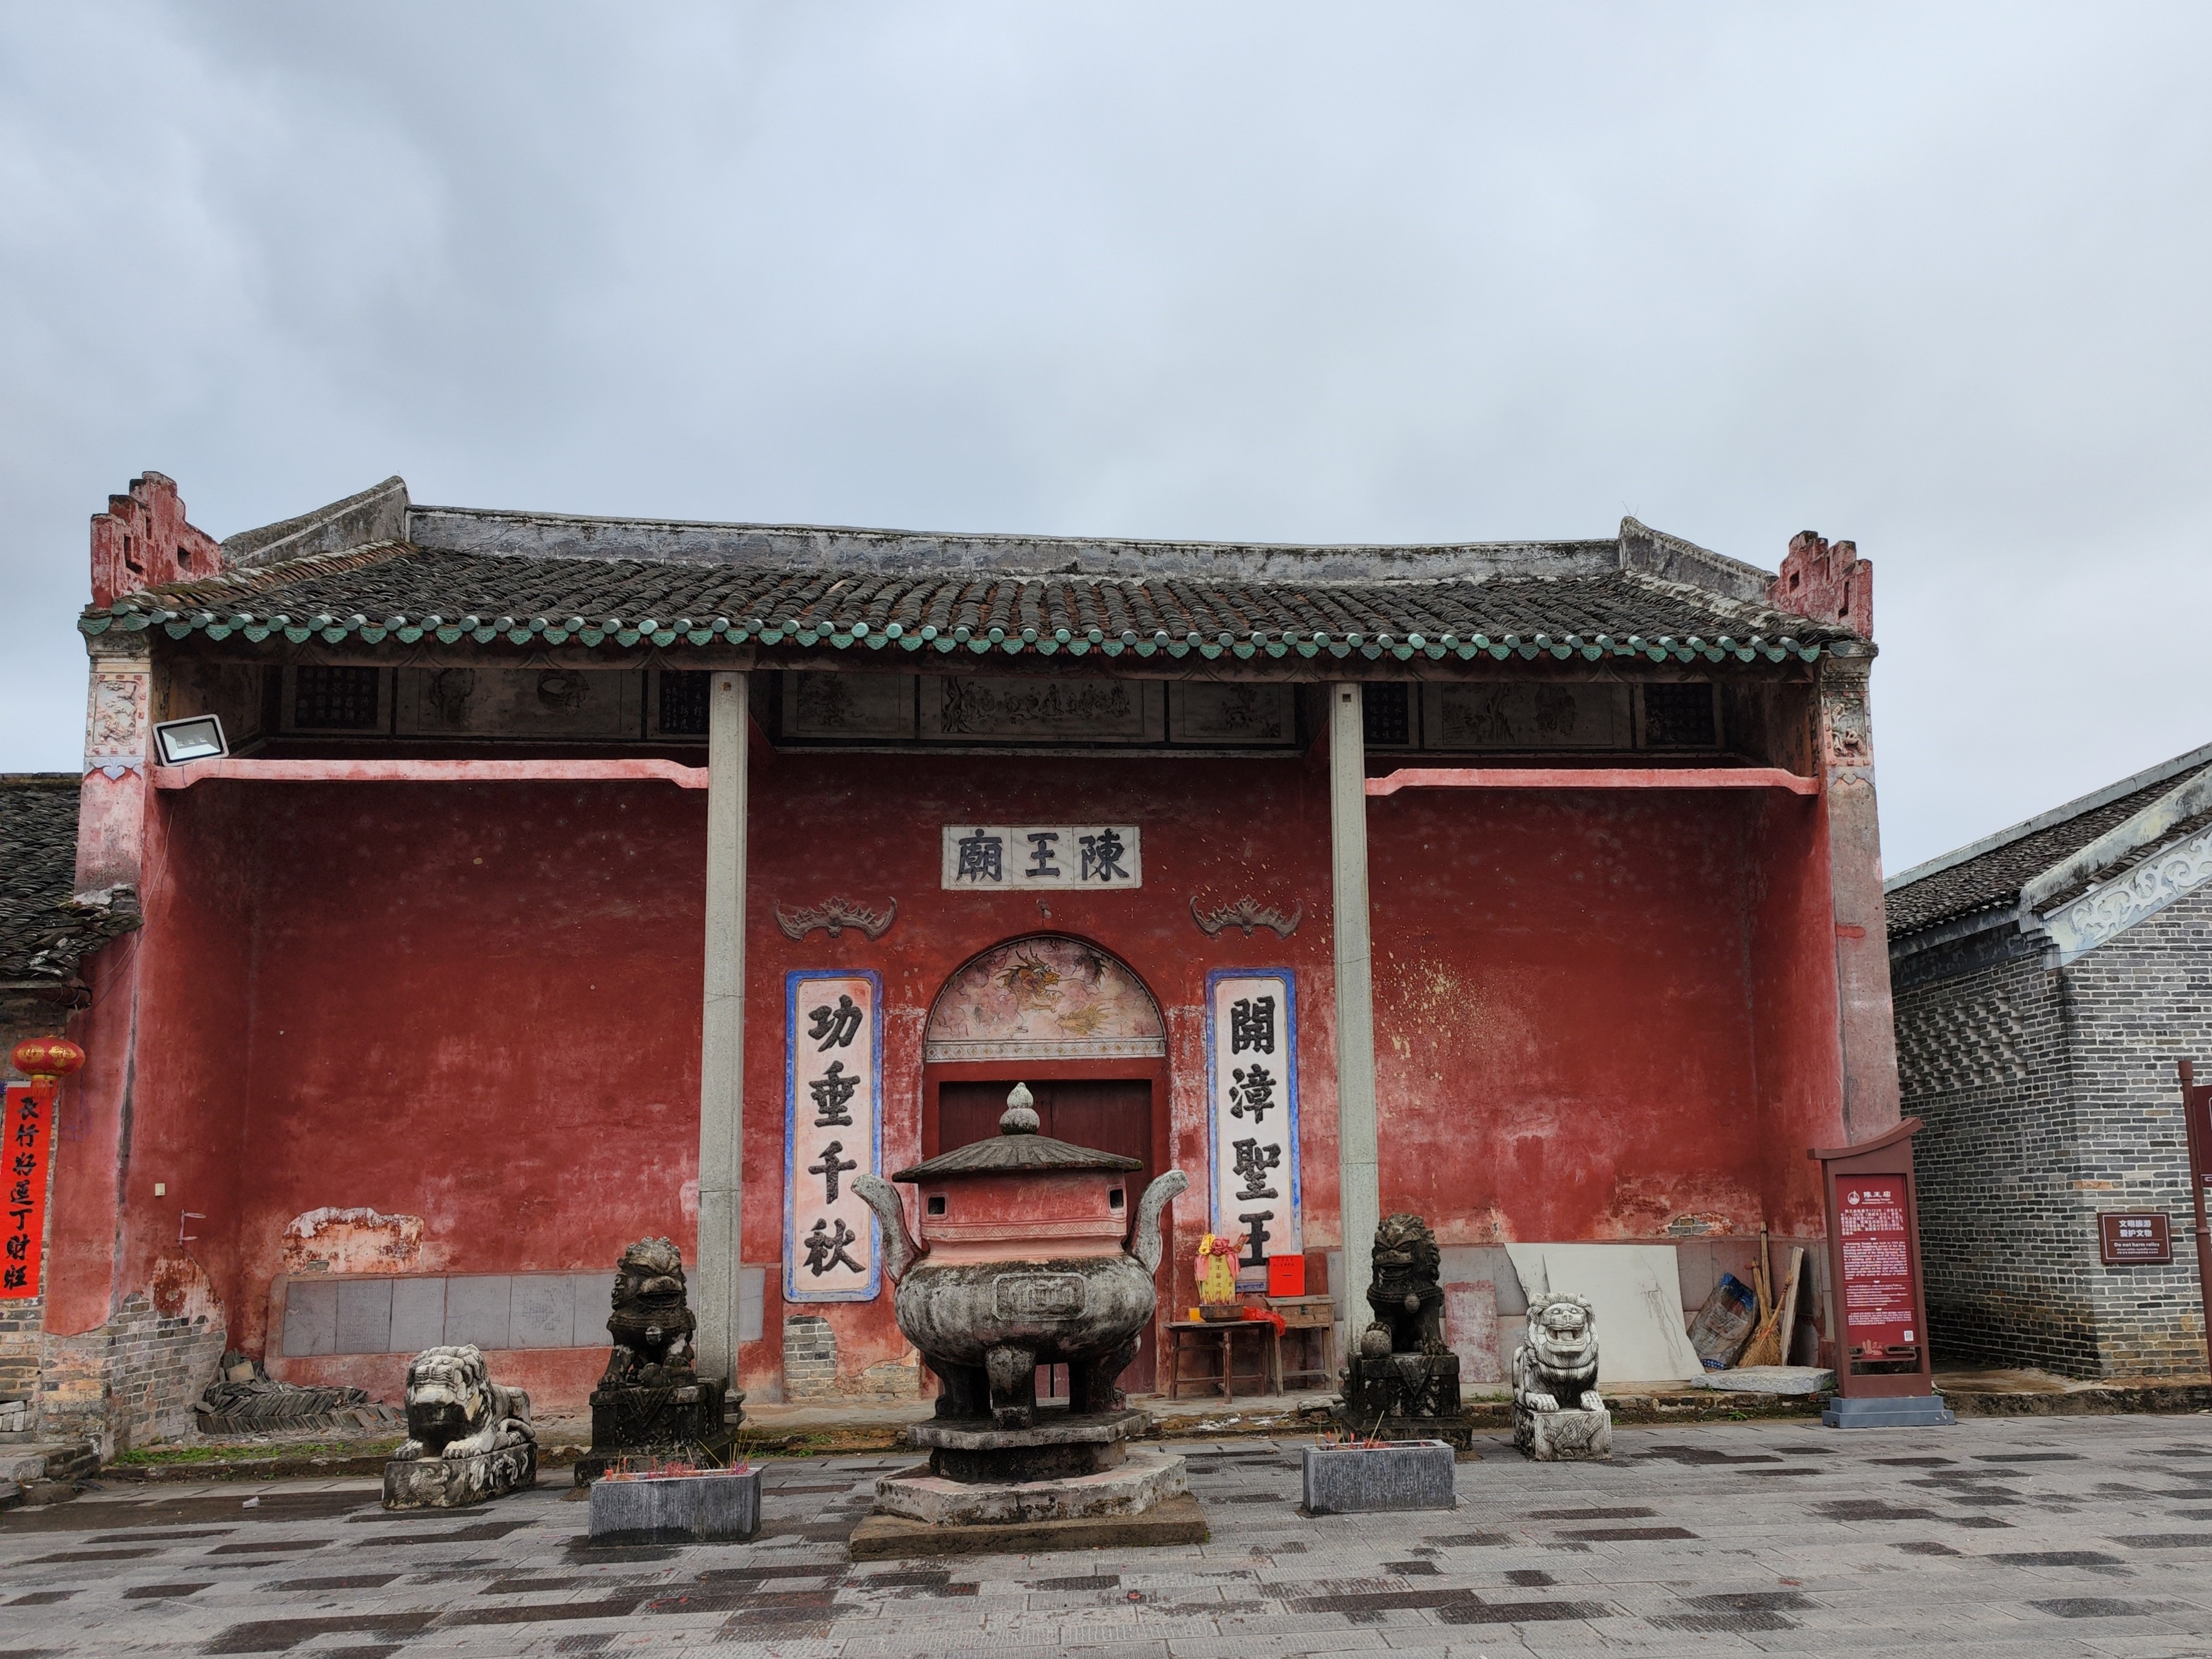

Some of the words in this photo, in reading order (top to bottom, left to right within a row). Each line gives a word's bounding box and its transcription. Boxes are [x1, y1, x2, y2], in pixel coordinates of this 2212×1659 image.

[956, 828, 1129, 882] 陳王廟
[804, 994, 866, 1277] 功垂千秋
[1229, 995, 1281, 1268] 開漳聖王
[2119, 1219, 2151, 1227] 文明旅游
[2120, 1229, 2153, 1238] 爱护文物
